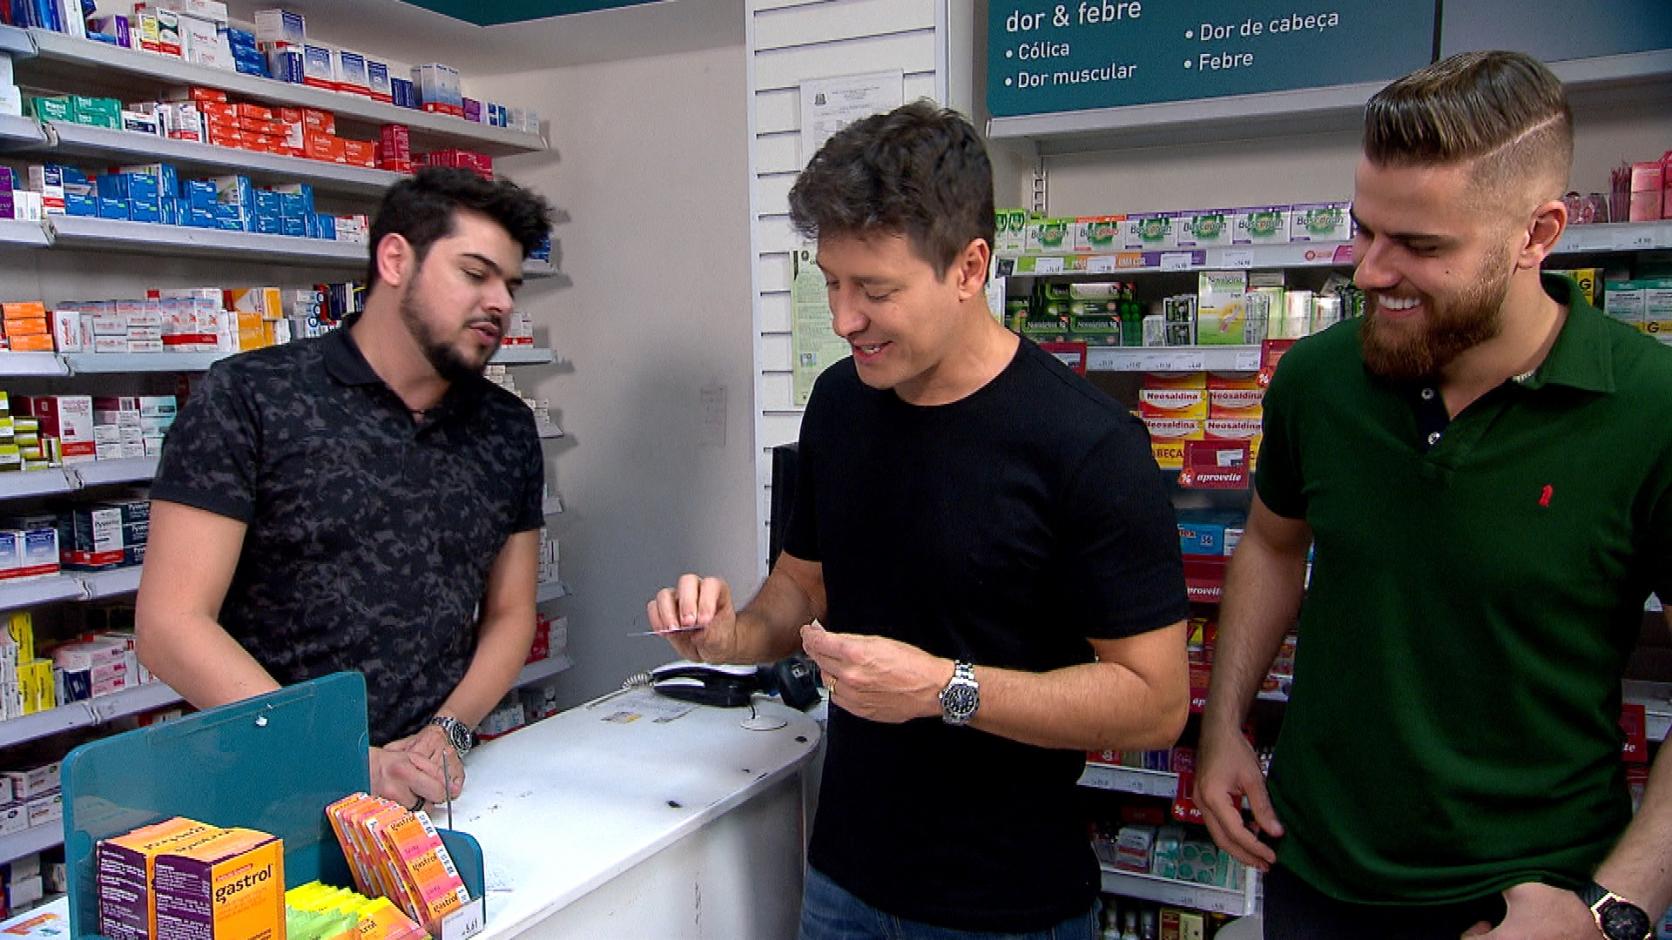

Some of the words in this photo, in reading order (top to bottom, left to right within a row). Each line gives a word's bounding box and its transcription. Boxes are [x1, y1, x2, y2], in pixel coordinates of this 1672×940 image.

[1006, 10, 1045, 32] dor
[1053, 5, 1070, 27] &
[1079, 1, 1142, 25] febre
[1200, 23, 1235, 41] Dor
[1240, 18, 1263, 36] de
[1269, 11, 1339, 33] cabeça
[1018, 42, 1070, 60] Cólica
[1199, 52, 1254, 71] Febre
[1018, 70, 1049, 88] Dor
[1053, 63, 1137, 86] muscular
[1147, 392, 1198, 400] Neosaldina
[1210, 391, 1262, 400] Neosaldina
[1208, 421, 1261, 430] Neosaldina
[1197, 472, 1242, 482] aproveite
[216, 864, 272, 904] gastrol
